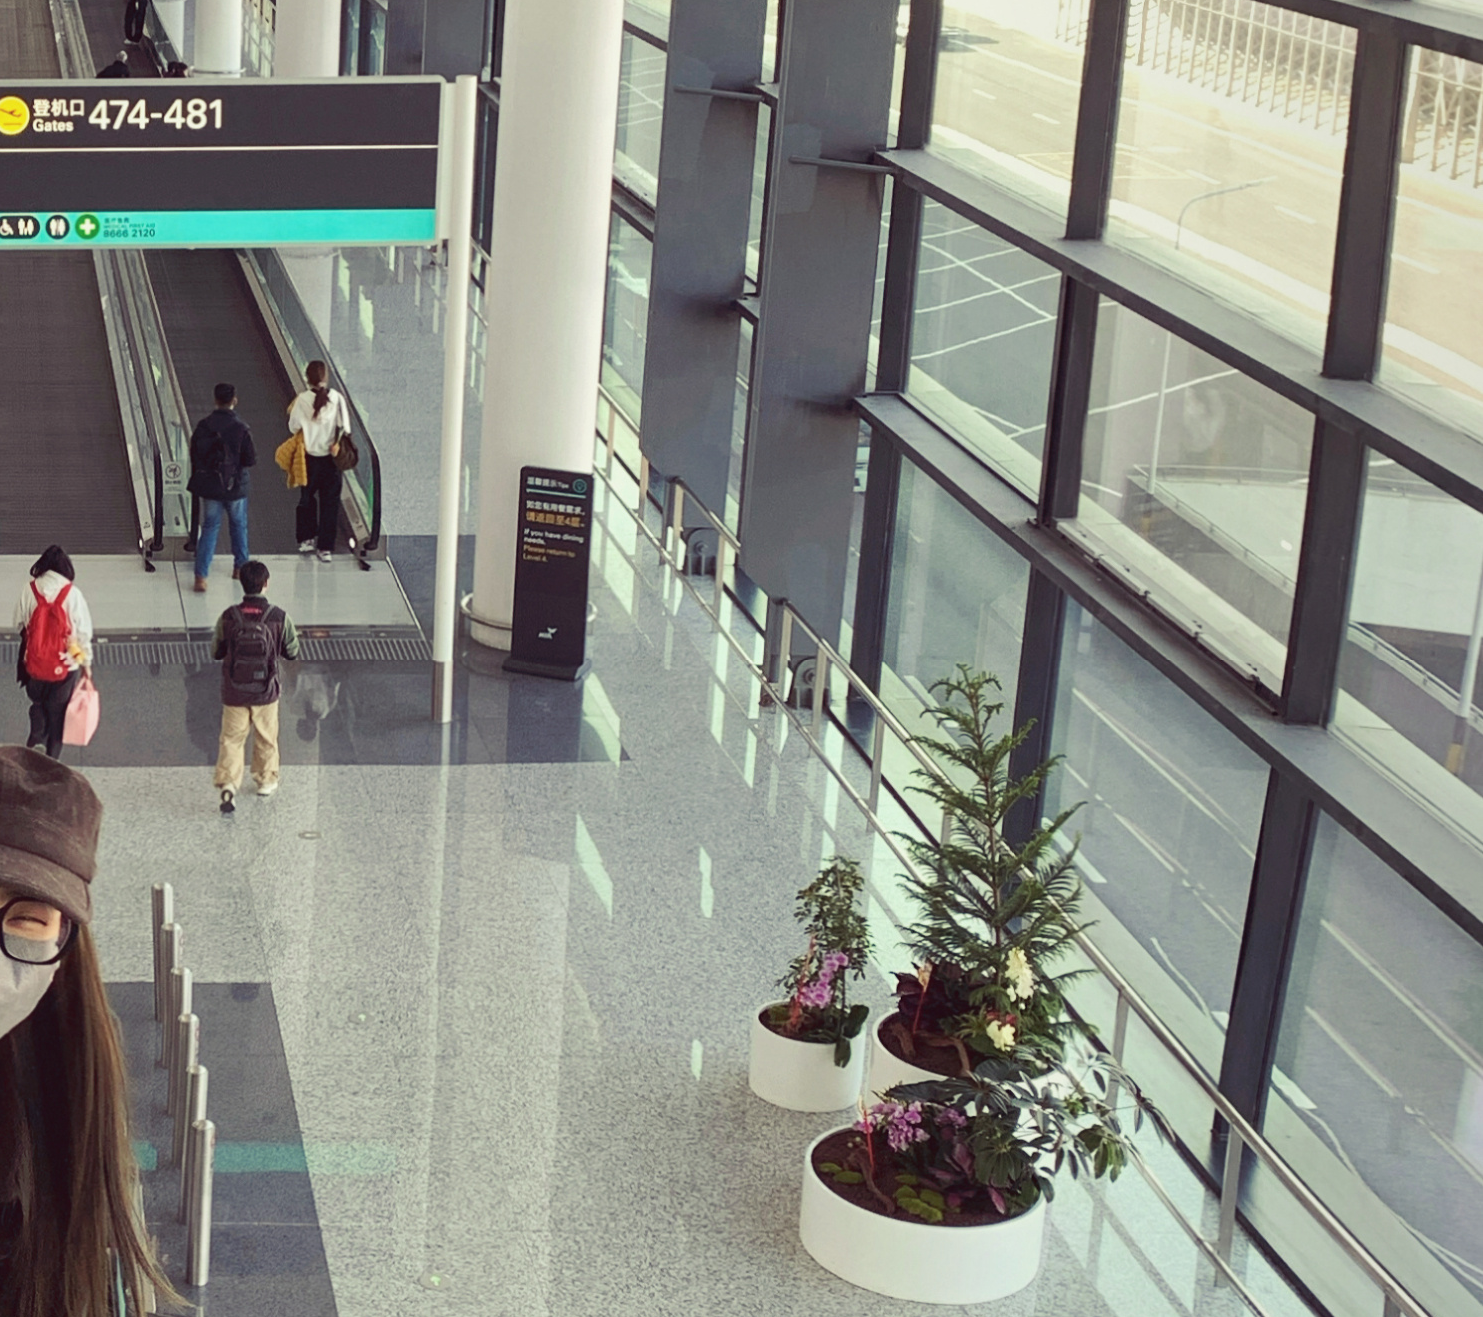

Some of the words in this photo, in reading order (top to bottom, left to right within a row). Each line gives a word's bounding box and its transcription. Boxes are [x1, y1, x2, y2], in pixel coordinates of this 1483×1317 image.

[32, 98, 85, 117] 登机口
[88, 98, 223, 130] 474-481
[32, 119, 74, 133] Gates
[103, 229, 129, 238] 8666
[131, 229, 155, 237] 2120
[544, 531, 561, 539] have
[562, 533, 584, 544] dining
[524, 544, 545, 554] Please
[546, 548, 567, 557] return
[523, 553, 541, 562] Level
